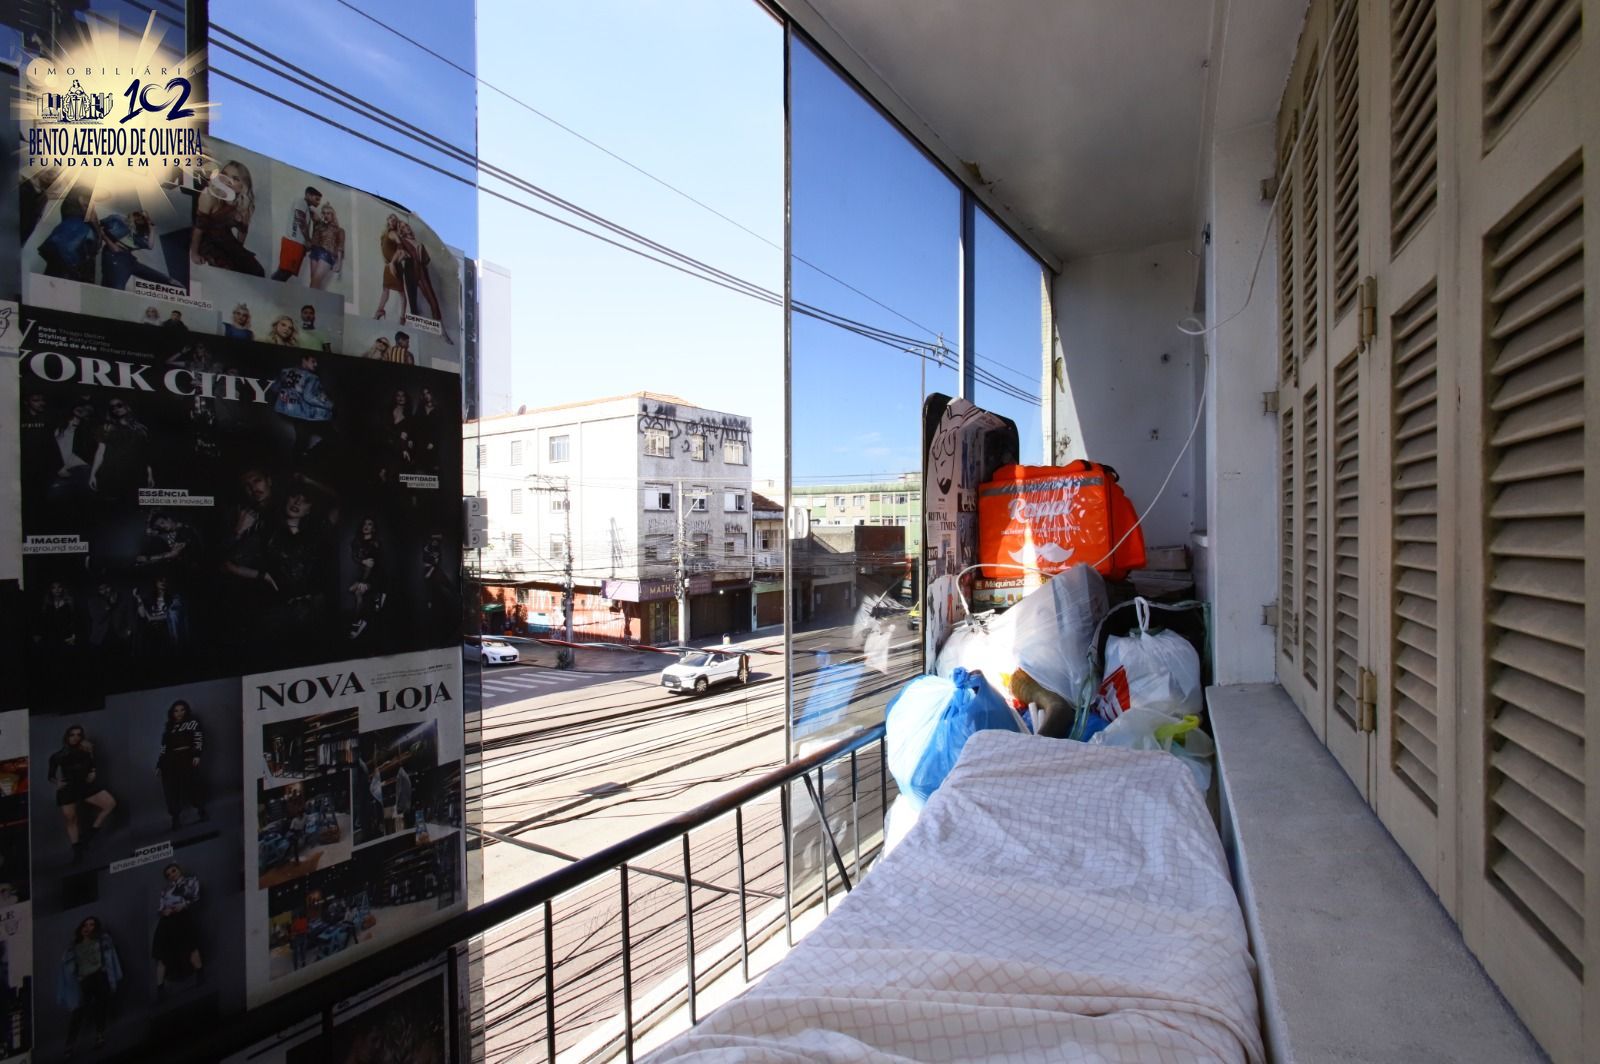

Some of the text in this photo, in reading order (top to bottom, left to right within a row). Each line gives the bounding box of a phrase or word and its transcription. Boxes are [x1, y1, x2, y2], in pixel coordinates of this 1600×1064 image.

[135, 281, 186, 297] ESSÊNCIA
[163, 368, 275, 404] CITY
[139, 489, 188, 498] ESSÊNCIA
[23, 544, 66, 553] erground
[31, 537, 78, 545] IMAGEM
[256, 671, 366, 711] NOVA
[377, 681, 453, 713] LOJA
[136, 843, 169, 857] PODER
